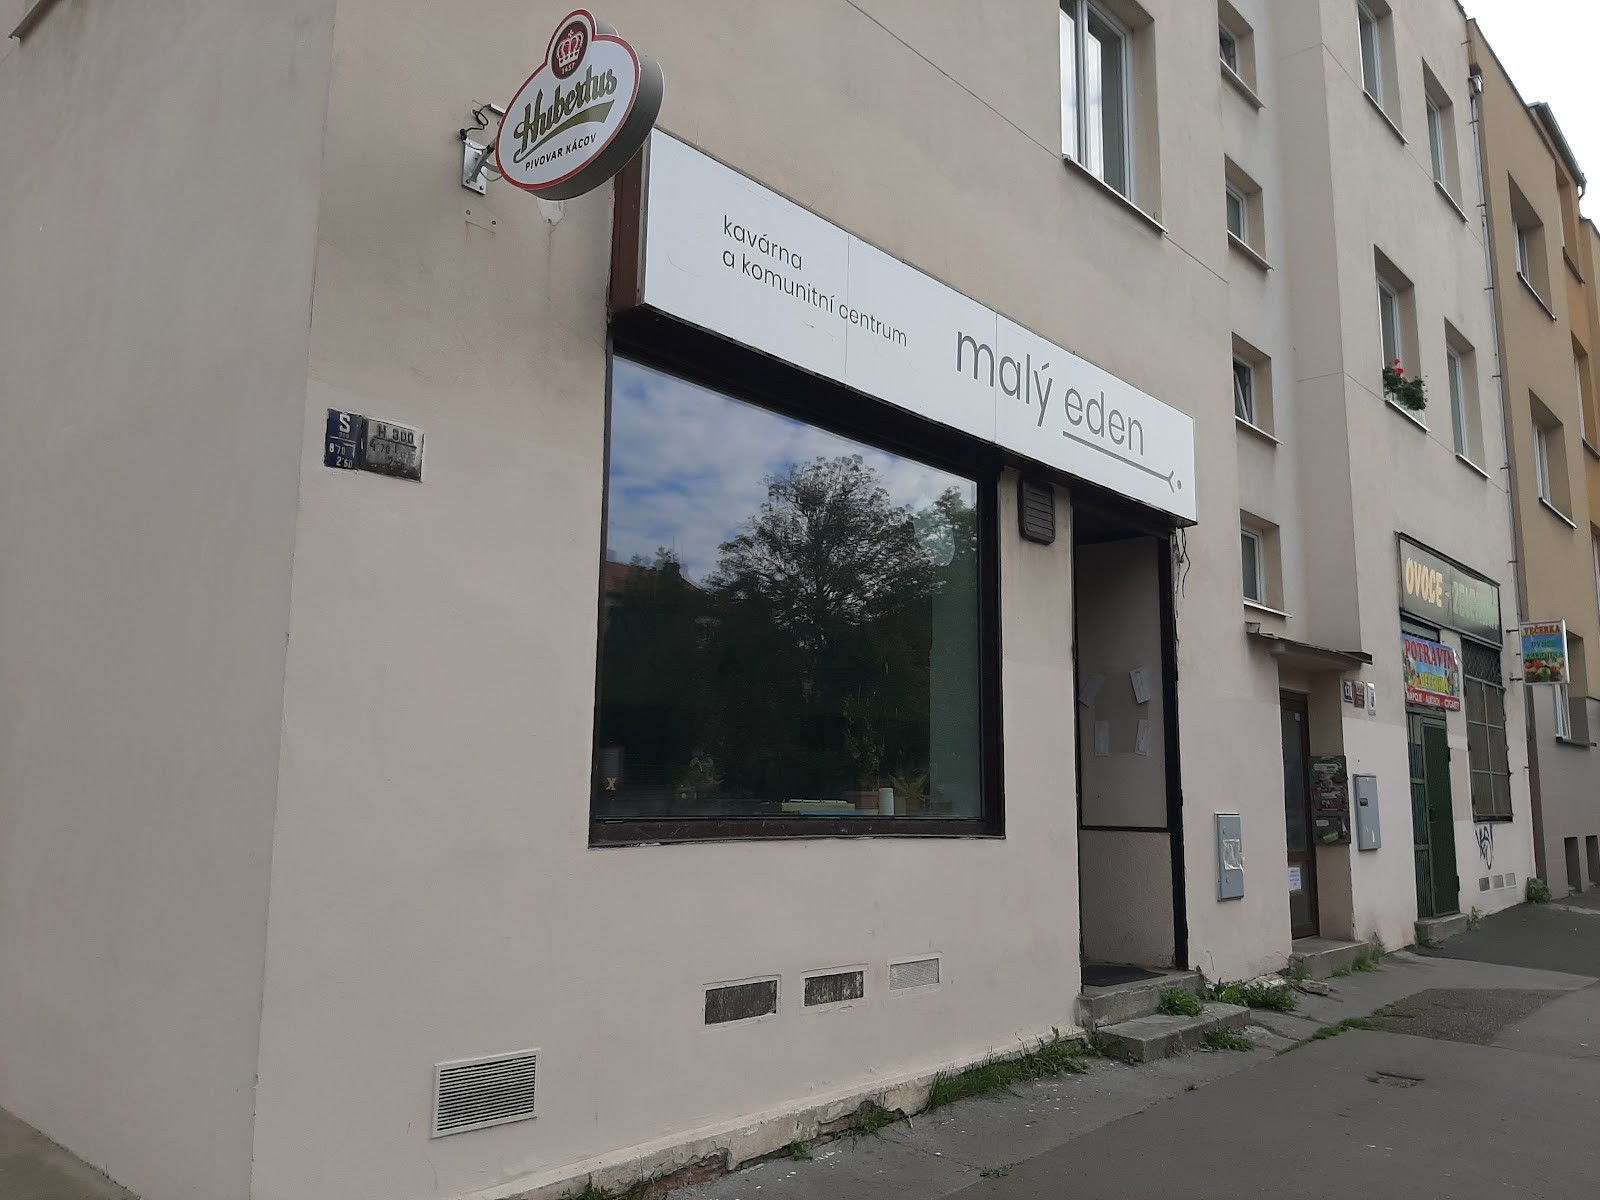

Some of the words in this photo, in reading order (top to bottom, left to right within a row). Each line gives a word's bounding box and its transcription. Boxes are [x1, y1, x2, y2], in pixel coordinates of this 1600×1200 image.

[513, 65, 618, 155] Hubertus
[525, 147, 563, 171] PIVOVAR
[565, 132, 597, 154] KÁCOV
[723, 214, 802, 270] kavárna
[722, 250, 735, 269] a
[742, 253, 835, 313] komunitní
[839, 304, 907, 347] centrum
[956, 331, 1053, 427] malý
[1064, 386, 1144, 456] eden
[340, 413, 350, 433] S
[1405, 557, 1443, 608] OVOCE
